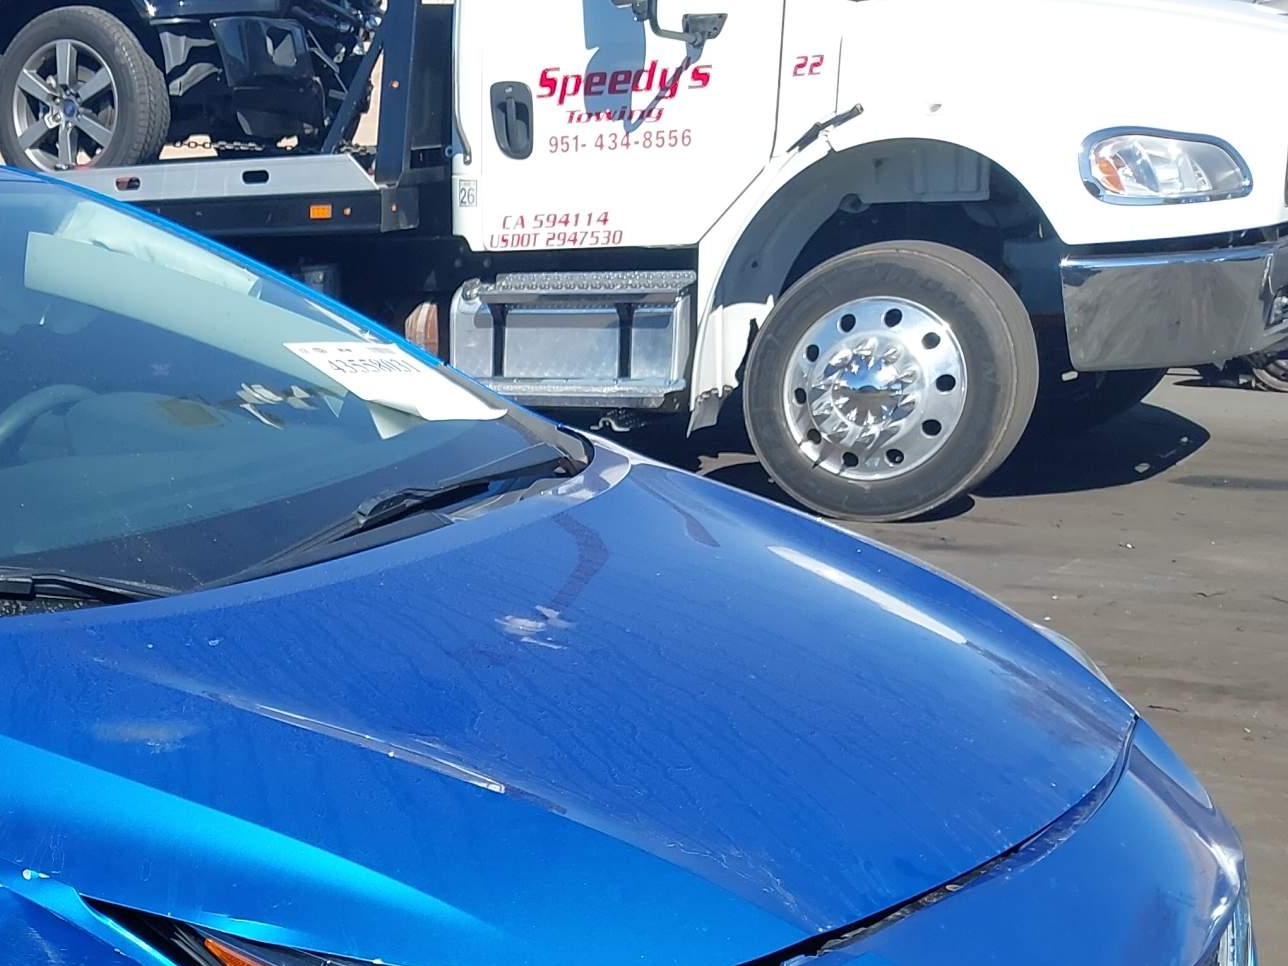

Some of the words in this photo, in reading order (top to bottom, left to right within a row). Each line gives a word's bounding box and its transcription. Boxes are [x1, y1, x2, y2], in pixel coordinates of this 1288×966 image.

[792, 54, 825, 77] 22
[536, 60, 713, 106] Speedy's
[565, 106, 665, 124] Towing
[460, 187, 475, 205] 26
[502, 215, 526, 230] CA
[531, 211, 609, 229] 594114
[489, 232, 541, 249] USDOT
[545, 230, 624, 248] 2947530
